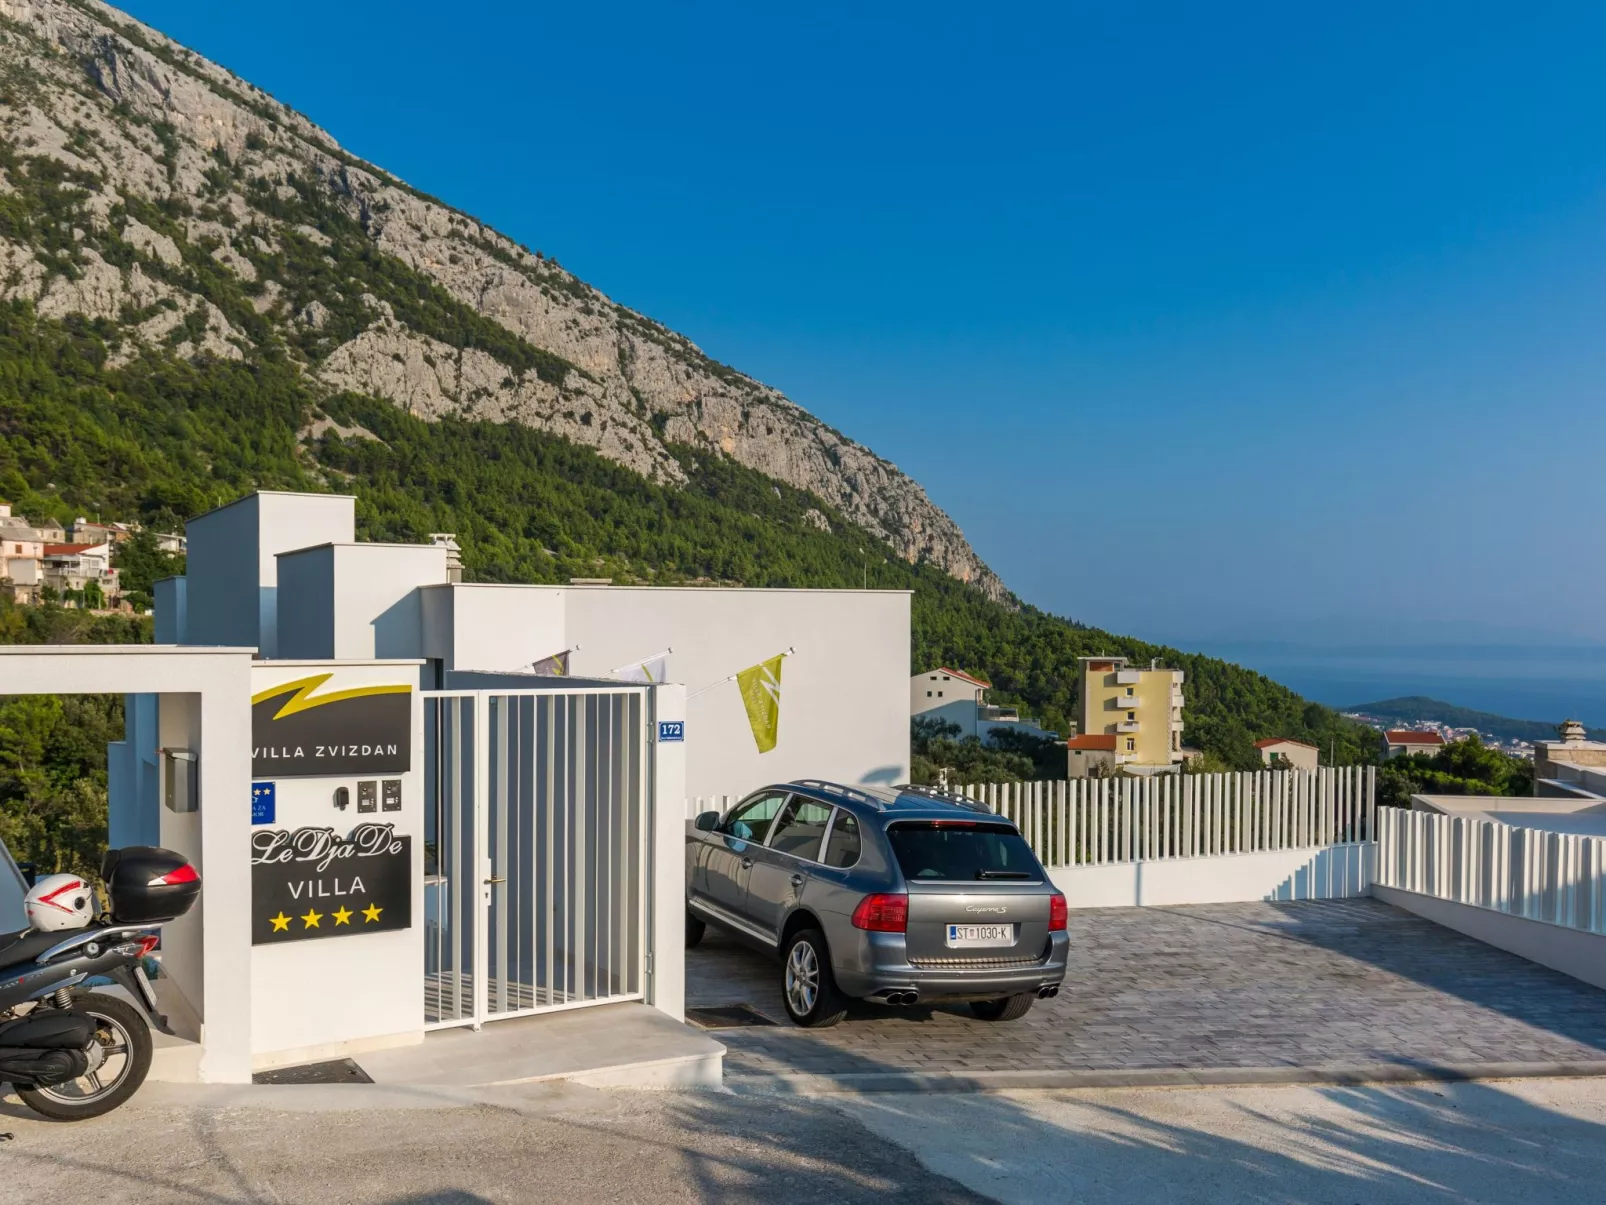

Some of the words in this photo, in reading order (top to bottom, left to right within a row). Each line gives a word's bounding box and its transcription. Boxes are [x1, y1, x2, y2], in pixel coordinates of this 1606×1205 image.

[662, 724, 681, 735] 172
[252, 747, 305, 759] VILLA
[315, 744, 398, 757] ZVIZDAN
[251, 831, 294, 865] Le
[293, 827, 356, 873] Dja
[355, 824, 403, 857] De
[287, 876, 366, 900] VILLA
[957, 927, 969, 940] ST
[976, 927, 1007, 939] 1030-K
